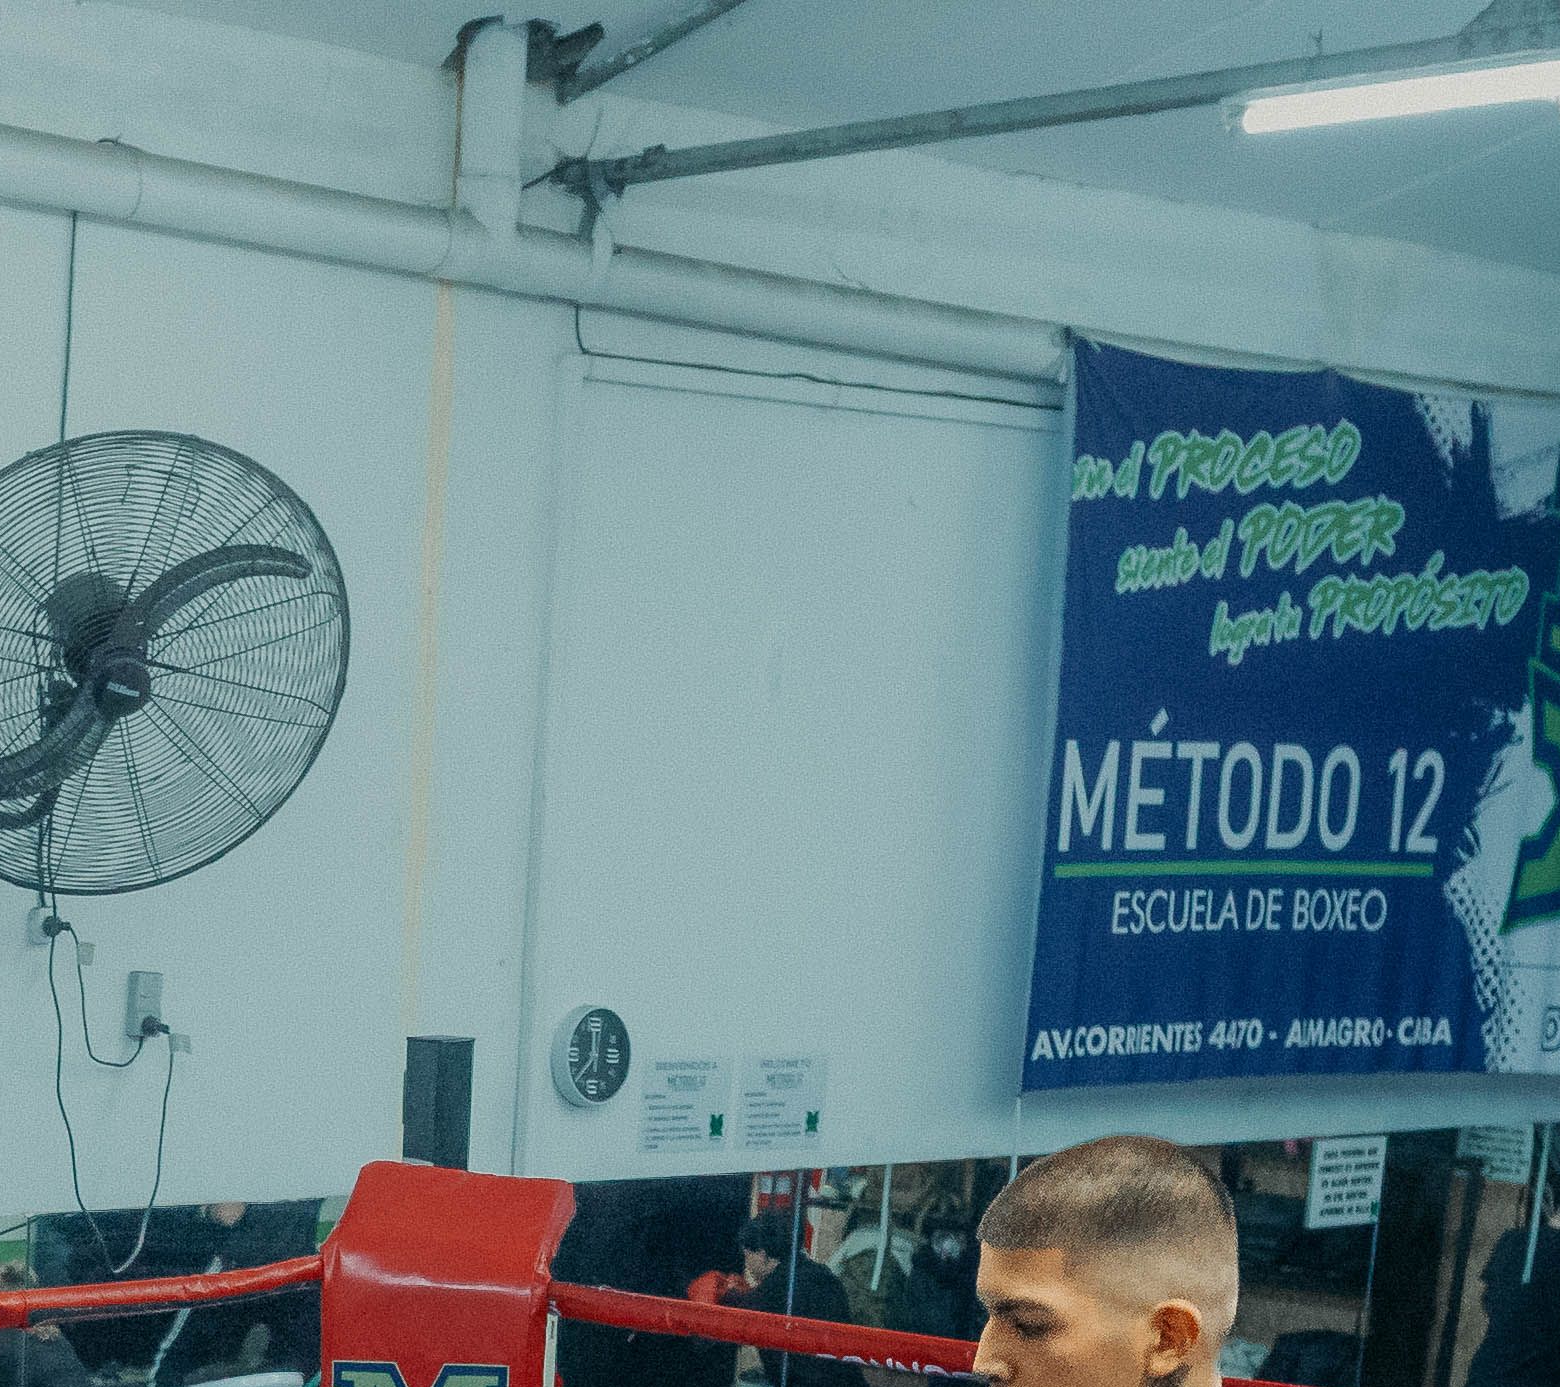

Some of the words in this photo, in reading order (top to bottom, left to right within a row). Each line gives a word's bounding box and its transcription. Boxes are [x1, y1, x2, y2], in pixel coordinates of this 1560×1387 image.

[1147, 417, 1362, 500] PROCESO
[1237, 495, 1406, 579] PODER
[1308, 550, 1530, 641] PROPÓSITO
[1058, 708, 1362, 853] MÉTODO
[1388, 747, 1446, 853] 12
[1111, 888, 1240, 935] ESCUELA
[1245, 889, 1283, 931] DE
[1292, 887, 1388, 932] BOXEO
